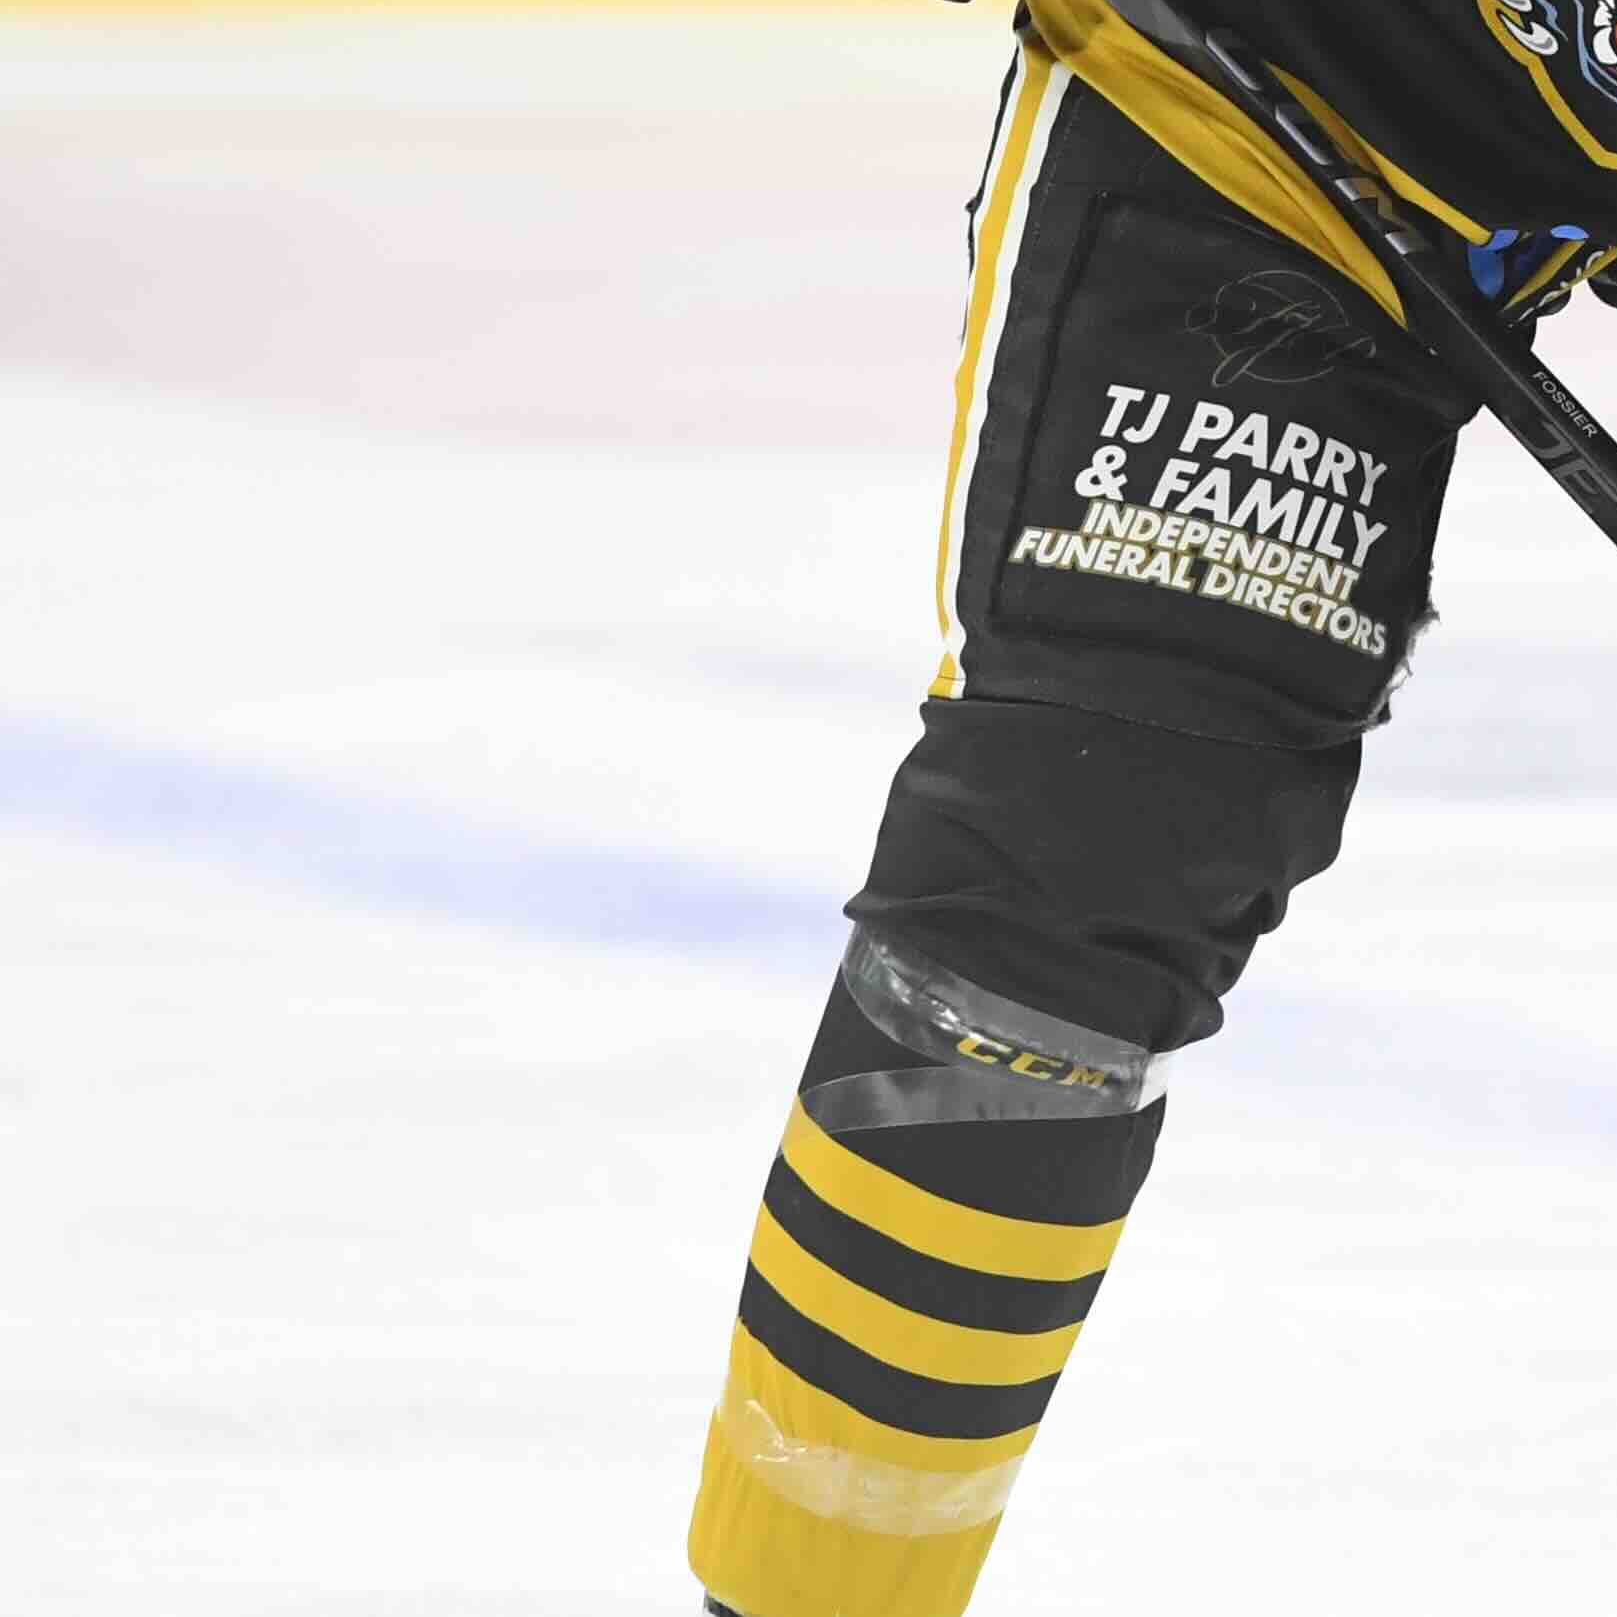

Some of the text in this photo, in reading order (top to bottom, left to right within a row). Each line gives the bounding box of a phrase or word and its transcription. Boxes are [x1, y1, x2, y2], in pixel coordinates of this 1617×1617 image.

[1099, 383, 1389, 508] TJ PARRY
[1532, 369, 1598, 438] FOSSIER
[1073, 444, 1389, 570] & FAMILY
[1083, 500, 1361, 603] INDEPENDENT
[1009, 527, 1387, 660] FUNERAL DIRECTORS
[955, 1035, 1106, 1088] CCM
